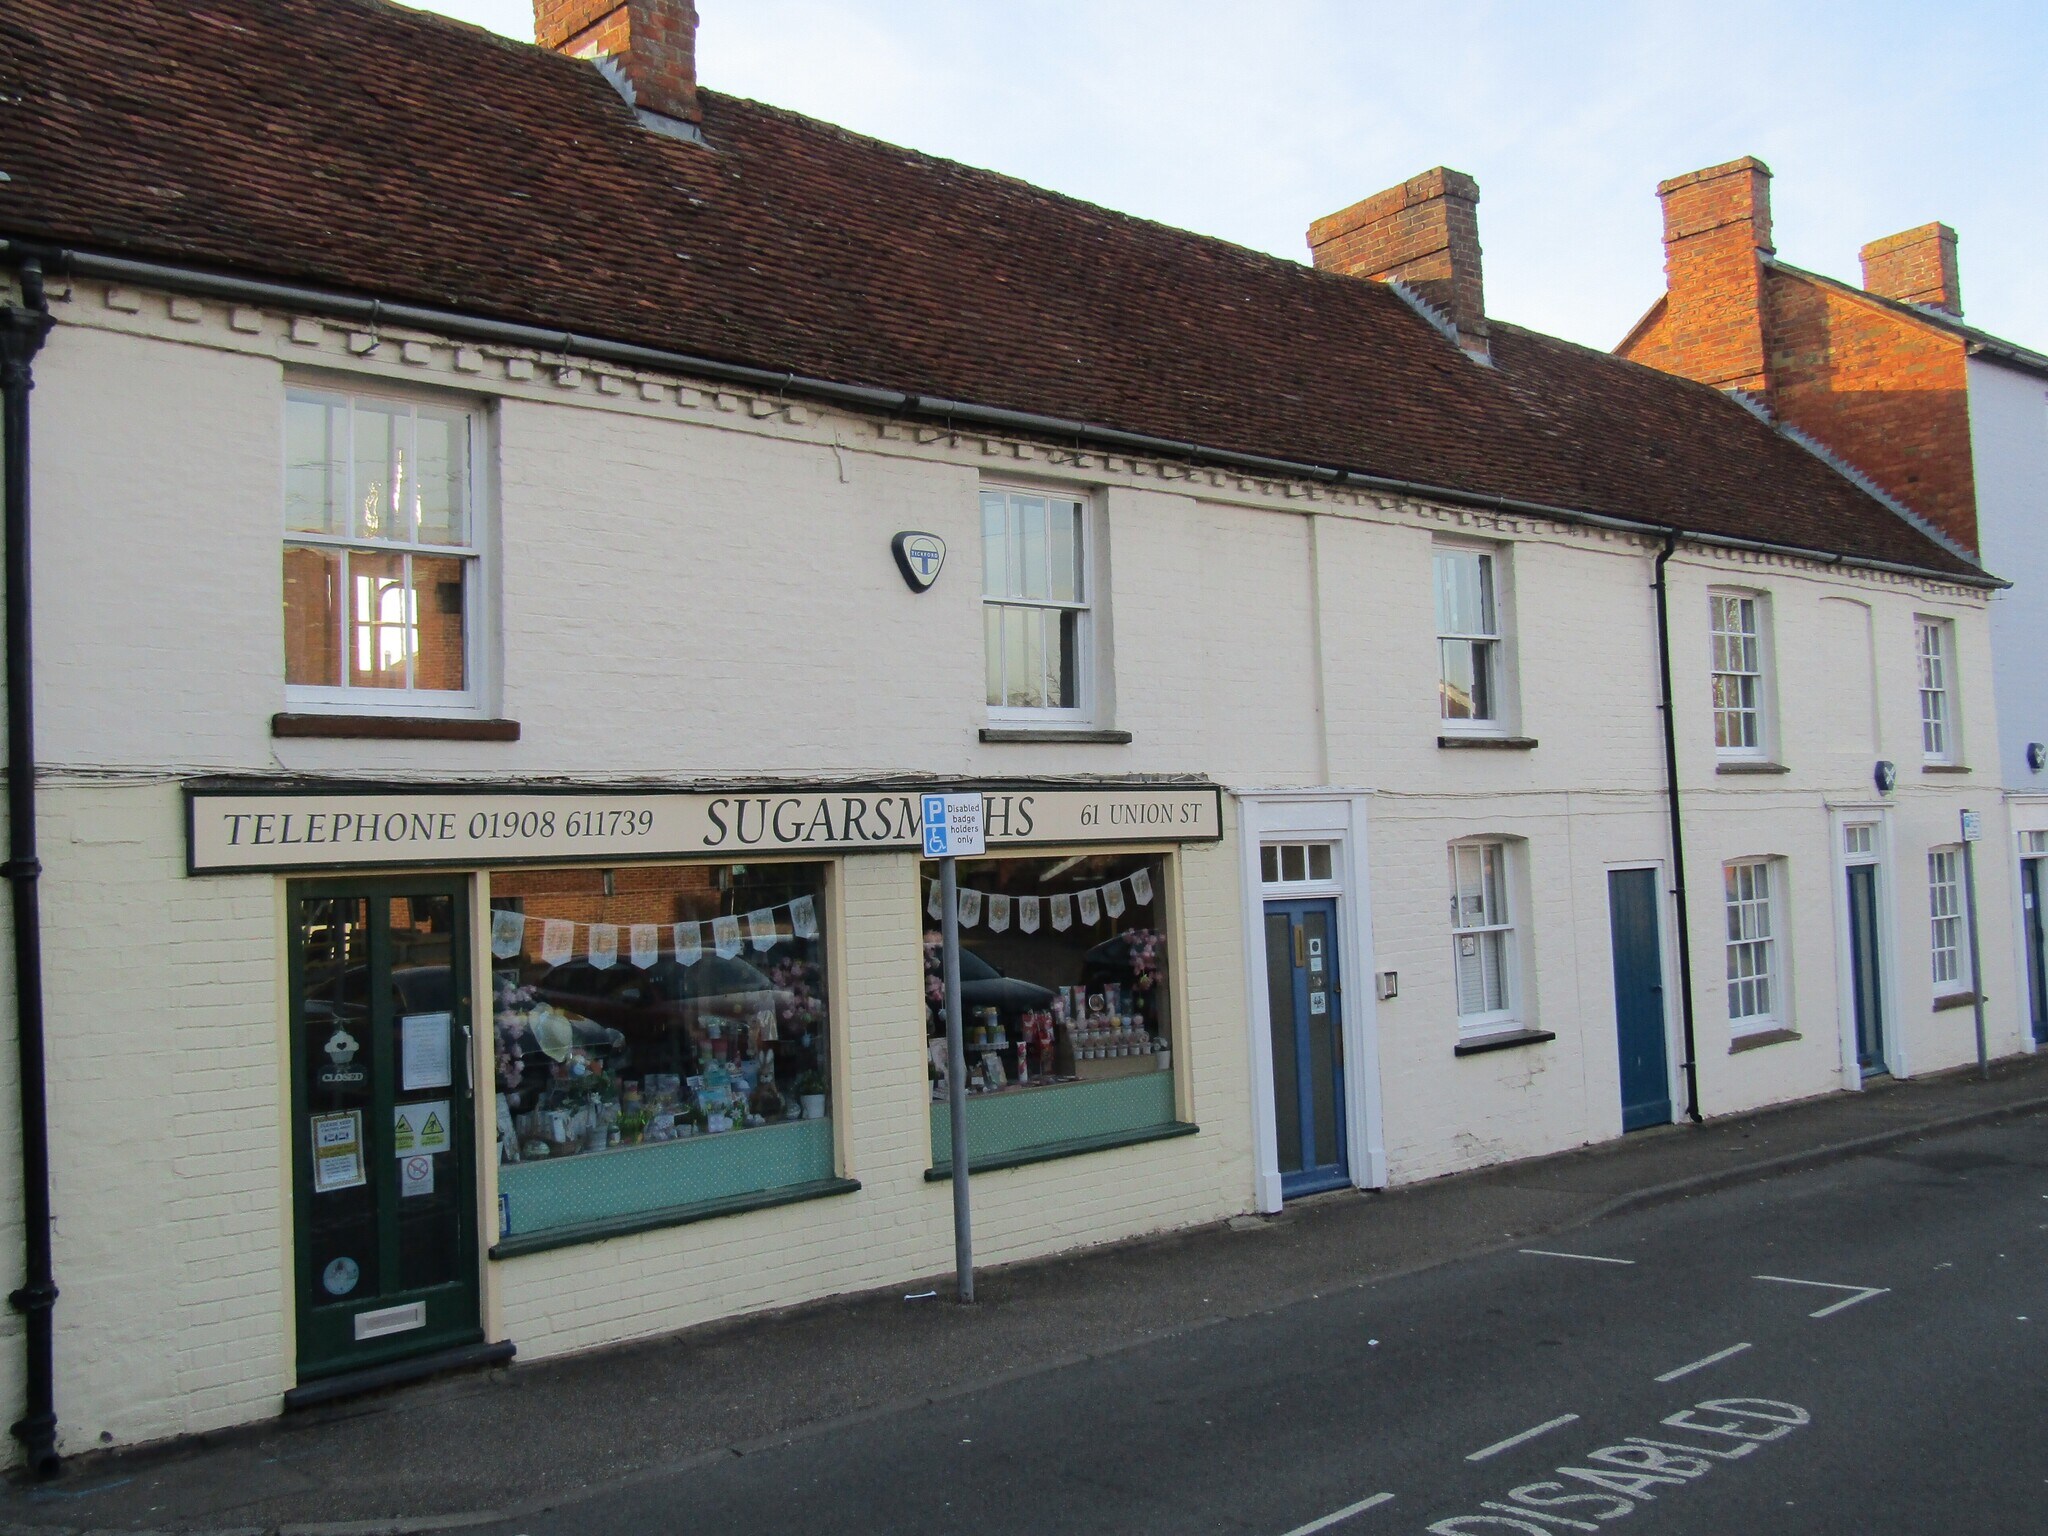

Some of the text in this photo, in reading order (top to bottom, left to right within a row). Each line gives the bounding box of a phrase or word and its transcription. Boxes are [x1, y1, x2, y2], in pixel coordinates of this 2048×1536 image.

[947, 804, 980, 813] Disabled
[952, 815, 976, 824] badge
[1080, 802, 1203, 827] 61 UNION ST
[702, 795, 1035, 846] SUGARSMHS
[223, 809, 655, 847] TELEPHONE 01908 611739
[950, 825, 979, 834] holders
[957, 835, 974, 845] only
